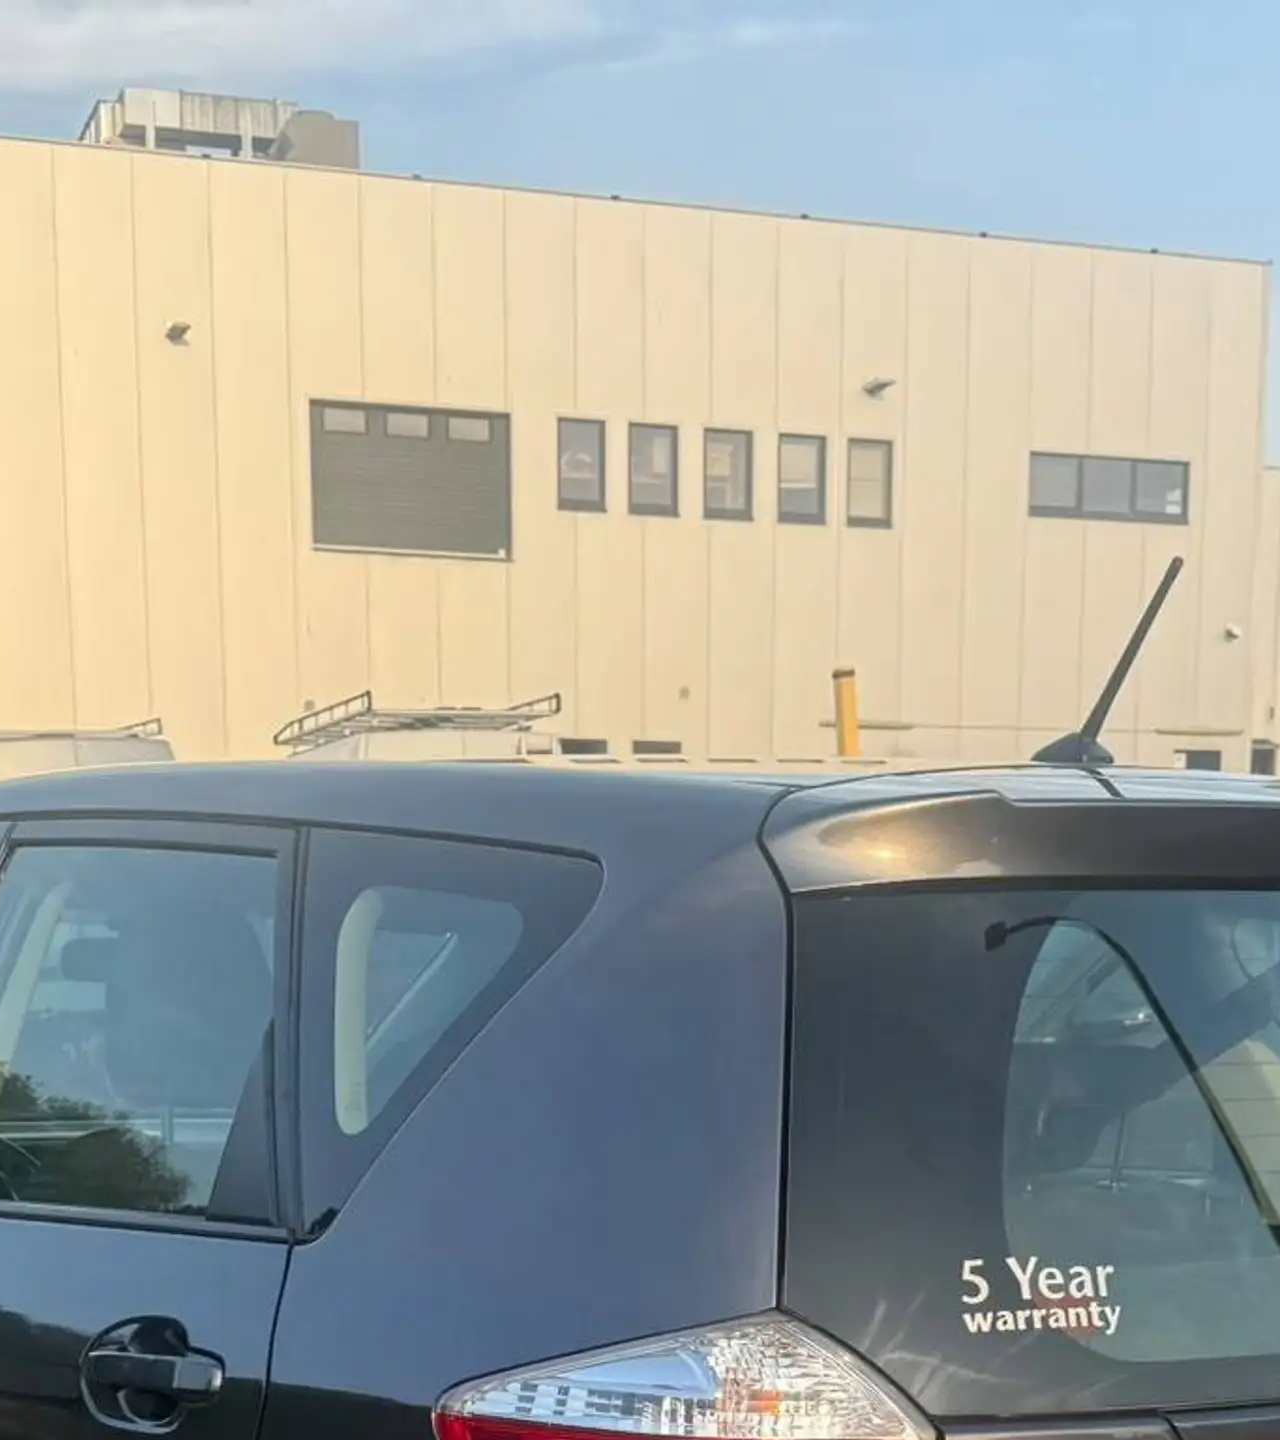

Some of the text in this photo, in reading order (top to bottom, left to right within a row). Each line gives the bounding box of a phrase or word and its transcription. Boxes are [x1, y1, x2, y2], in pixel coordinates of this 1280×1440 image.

[961, 1255, 1115, 1305] 5 Year
[962, 1301, 1121, 1336] warranty
